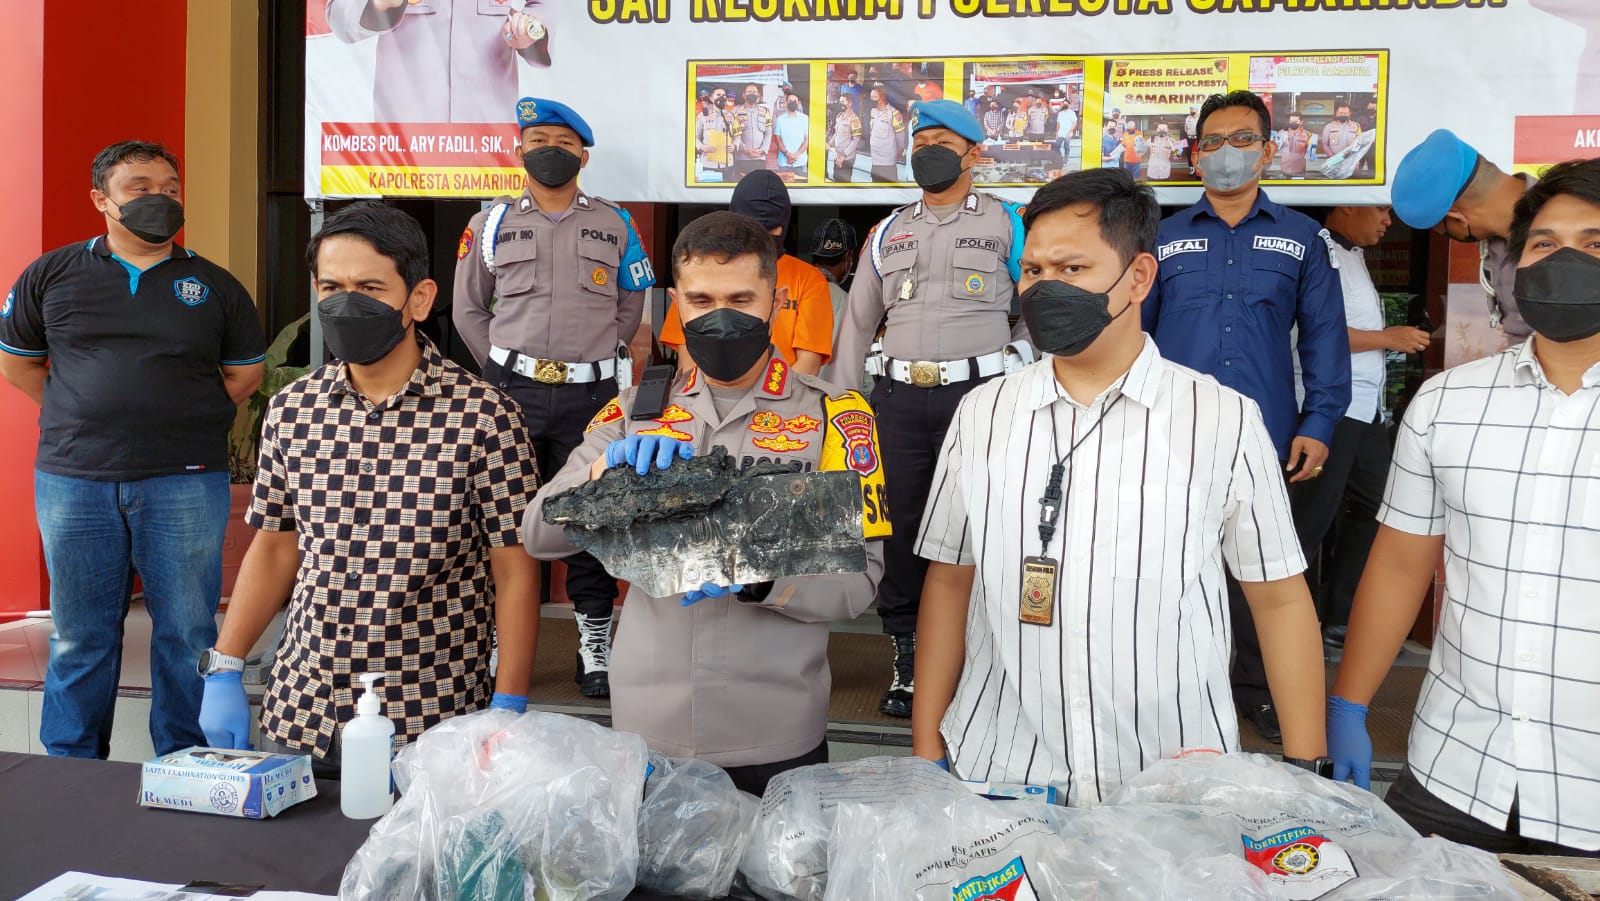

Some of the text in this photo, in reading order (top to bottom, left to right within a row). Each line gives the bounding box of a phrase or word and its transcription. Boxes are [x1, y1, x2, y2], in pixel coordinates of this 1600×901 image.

[1166, 68, 1213, 76] RELEASE
[1124, 94, 1209, 104] SAMARIND
[324, 135, 376, 152] KOMBES
[379, 135, 406, 152] POL.
[410, 136, 435, 152] ARY
[439, 136, 478, 154] FADLI,
[369, 172, 528, 190] KAPOLRESTA SAMARINDA
[520, 229, 533, 240] DIO
[581, 228, 617, 246] POLRI
[959, 239, 996, 250] POLRI
[1162, 239, 1203, 257] RIZAL
[1258, 238, 1301, 255] HUMAS
[145, 766, 245, 782] LATEX EXAMINATION GLOVES
